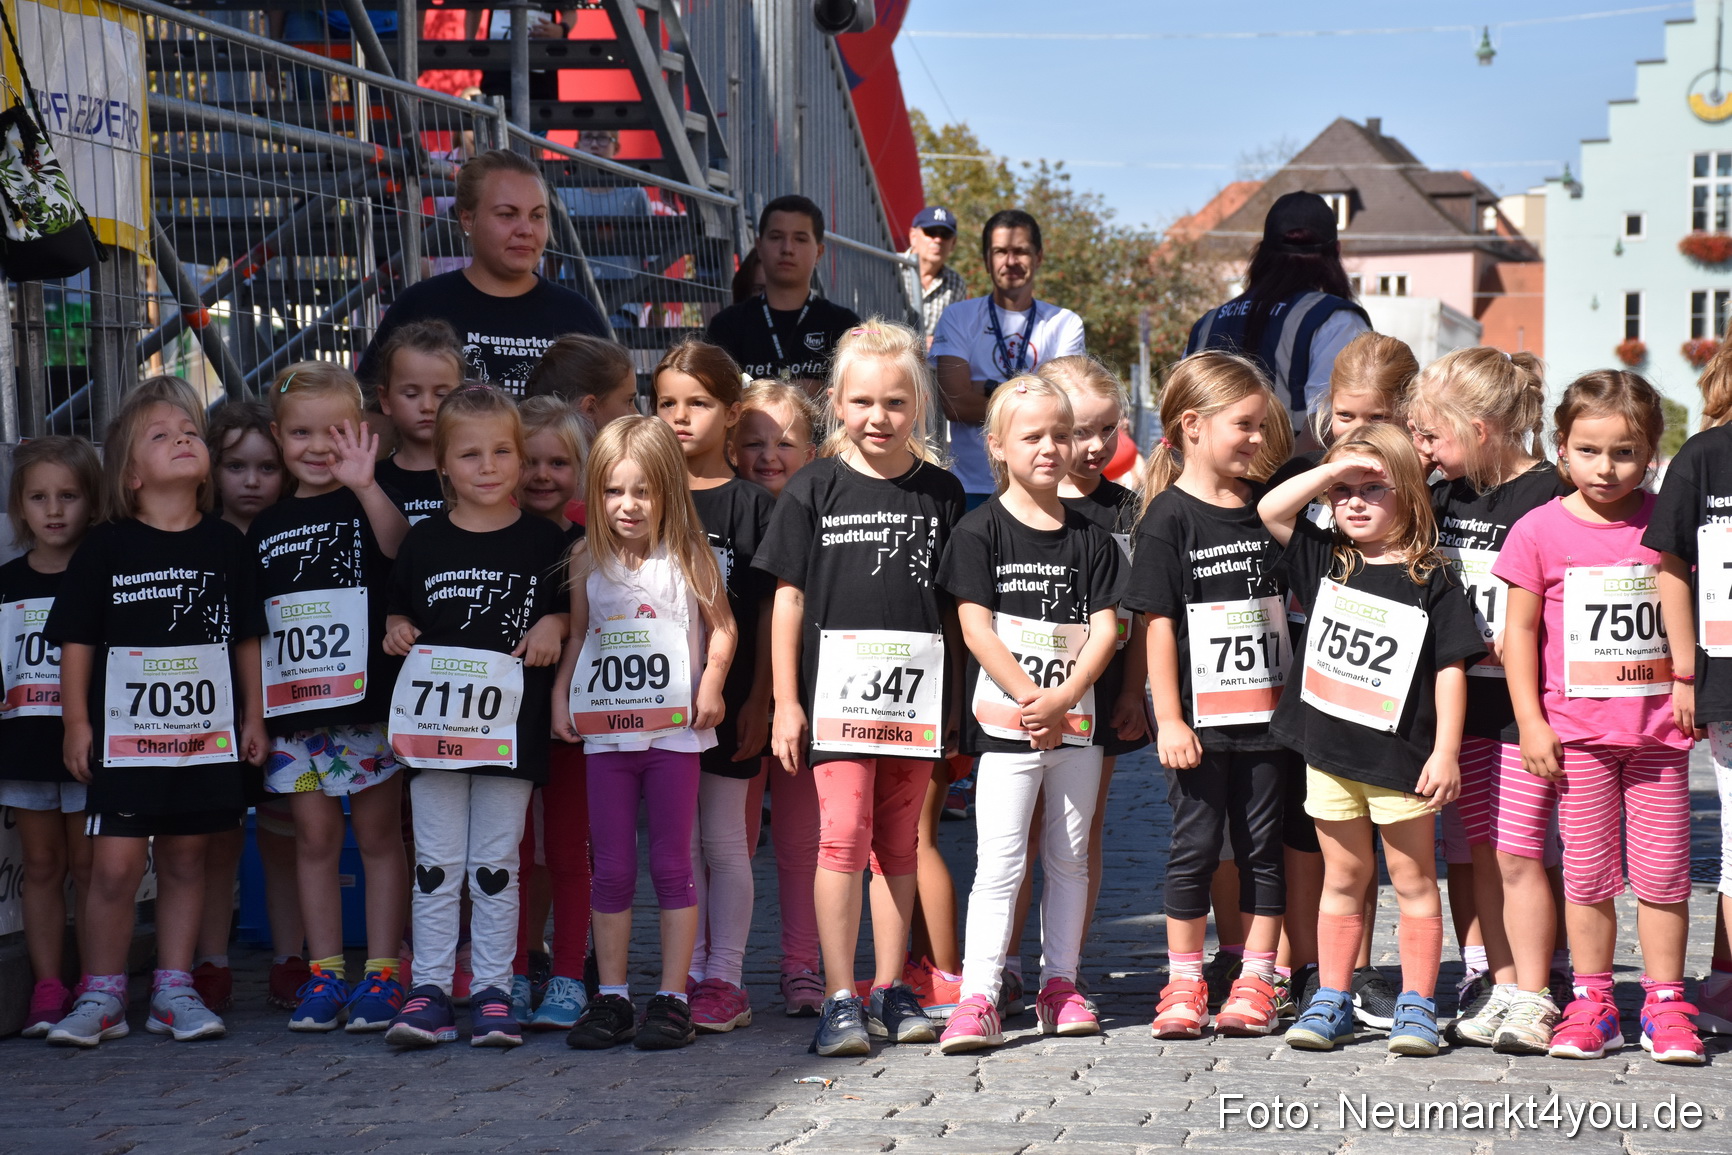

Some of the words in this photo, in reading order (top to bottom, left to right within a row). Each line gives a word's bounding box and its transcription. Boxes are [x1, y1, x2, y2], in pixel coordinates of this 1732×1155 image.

[494, 346, 548, 357] STADTL
[745, 362, 772, 376] get
[822, 511, 907, 528] Neumarkter
[822, 528, 890, 546] Stadtlauf
[261, 538, 314, 569] Sdtlauf
[1189, 541, 1262, 562] Neumarkter
[1193, 557, 1252, 580] Stadtlauf
[1446, 559, 1488, 574] OCK
[112, 567, 199, 587] Neumarkter
[424, 568, 503, 591] Neumarkter
[1604, 576, 1657, 592] BOCK
[112, 584, 183, 605] Stadtlauf
[995, 579, 1050, 594] tadtlauf
[427, 585, 484, 607] Sadtlauf
[281, 601, 331, 619] BOCK
[1227, 608, 1270, 625] BOCK
[1334, 596, 1389, 624] BOCK
[273, 623, 351, 666] 7032
[600, 630, 650, 646] BOCK
[1021, 630, 1068, 648] BOCK
[1317, 615, 1398, 675] 7552
[857, 642, 911, 656] BOCK
[1210, 631, 1280, 673] 7517
[1594, 648, 1624, 656] PARTL
[1626, 646, 1660, 656] Neumarkt
[143, 657, 199, 671] BOCK
[281, 669, 298, 678] PARTL
[299, 665, 334, 674] Neumarkt
[431, 657, 488, 675] BOCK
[1197, 667, 1206, 675] B1
[587, 653, 670, 693] 7099
[1220, 677, 1247, 686] PARTL
[1332, 666, 1369, 683] Neumarkt
[1616, 664, 1654, 682] Julia
[27, 688, 60, 702] Lara
[126, 679, 216, 717] 7030
[291, 683, 331, 700] Emma
[412, 680, 502, 720] 7110
[591, 698, 613, 706] PARTL
[615, 696, 652, 705] Neumarkt
[110, 709, 119, 717] B1
[842, 706, 869, 715] PARTL
[871, 707, 905, 717] Neumarkt
[163, 721, 200, 730] Neumarkt
[417, 722, 441, 731] PARTL
[442, 724, 478, 733] Neumarkt
[607, 713, 644, 730] Viola
[841, 722, 913, 742] Franziska
[137, 738, 205, 754] Charlotte
[437, 740, 463, 756] Eva
